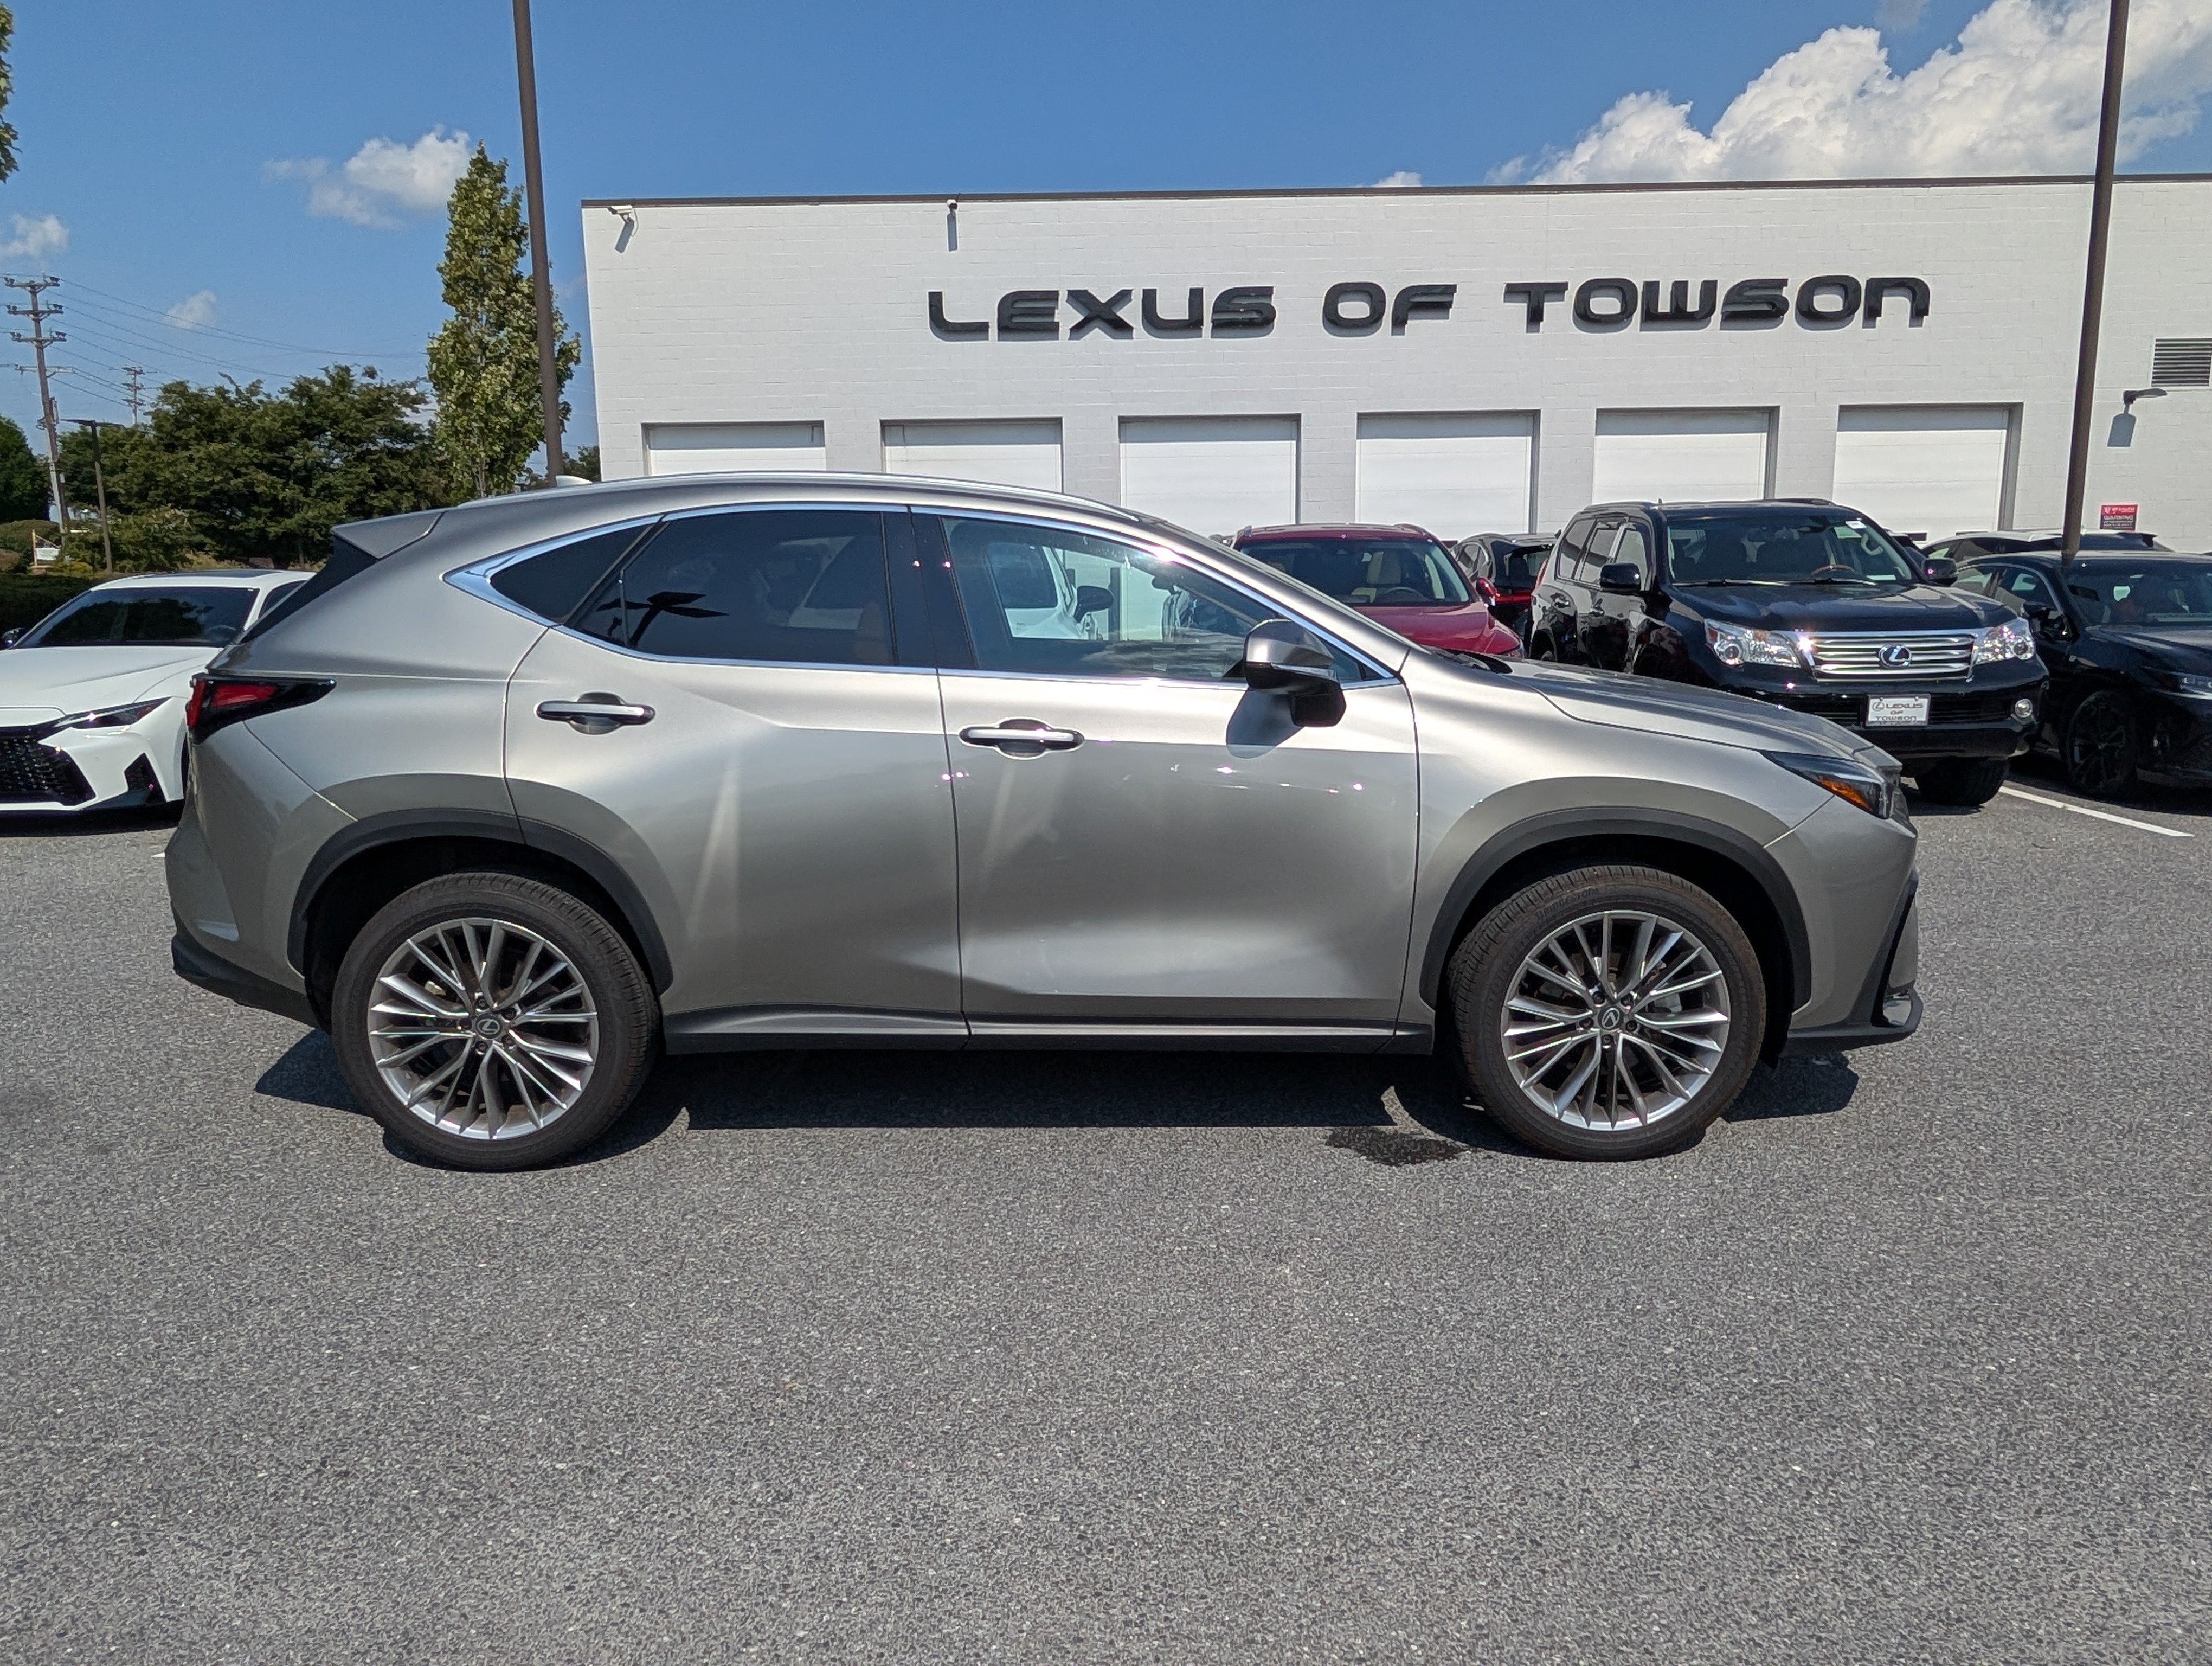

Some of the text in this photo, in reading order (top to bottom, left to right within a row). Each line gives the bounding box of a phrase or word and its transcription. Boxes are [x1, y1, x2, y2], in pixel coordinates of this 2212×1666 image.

[928, 275, 1931, 336] LEXUS OF TOWSON
